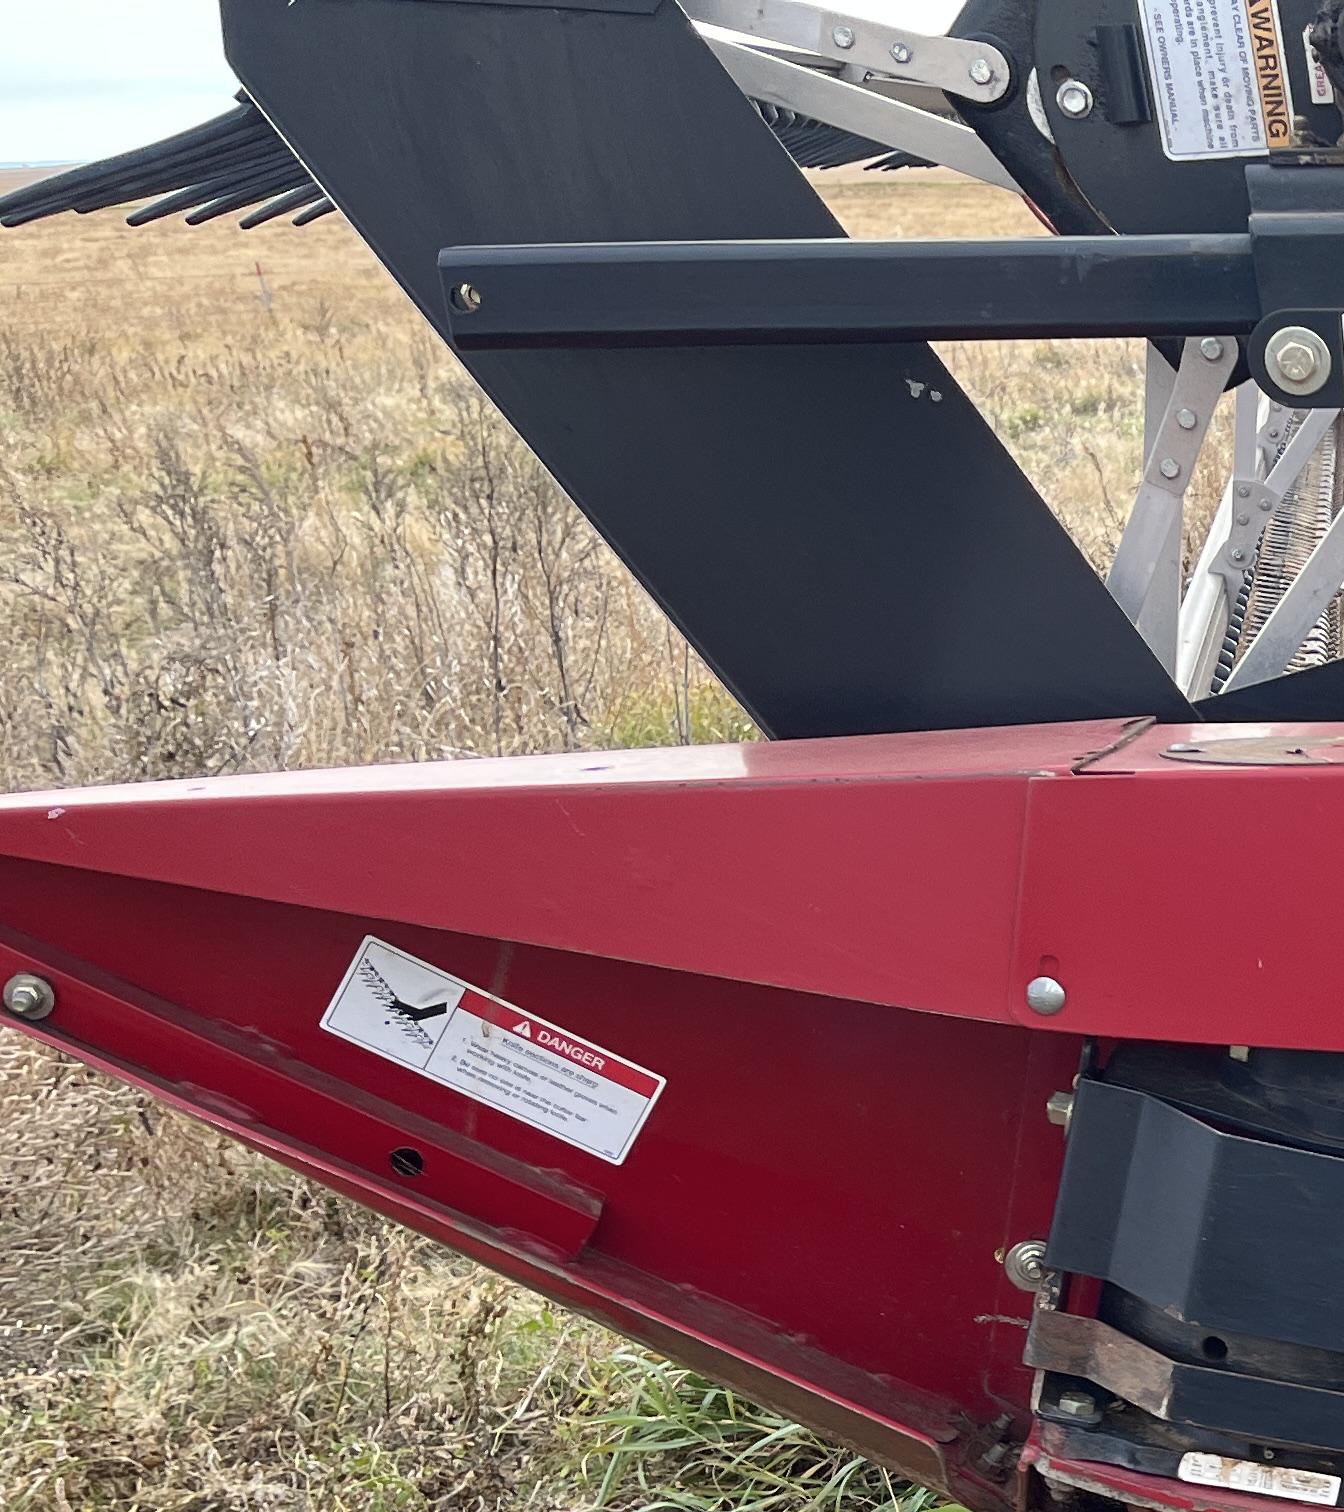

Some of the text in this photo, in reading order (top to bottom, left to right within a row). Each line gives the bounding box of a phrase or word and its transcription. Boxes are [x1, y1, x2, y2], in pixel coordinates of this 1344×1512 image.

[1186, 20, 1195, 36] are
[1232, 14, 1245, 48] CLEAR
[1190, 39, 1198, 48] in
[1215, 43, 1227, 73] injury
[1238, 51, 1248, 64] OF
[1154, 13, 1164, 33] SEE
[1165, 82, 1179, 125] MANUAL
[1190, 51, 1202, 77] place
[1250, 7, 1288, 139] WARNING
[1196, 80, 1207, 106] when
[1221, 76, 1230, 88] or
[1241, 67, 1254, 107] MOVING
[1208, 70, 1218, 99] make
[1213, 105, 1223, 130] sure
[1218, 136, 1228, 148] all
[1224, 91, 1234, 120] death
[1202, 108, 1214, 149] machine
[1230, 124, 1238, 148] from
[1248, 109, 1260, 142] PARTS
[537, 1030, 605, 1070] DANGER
